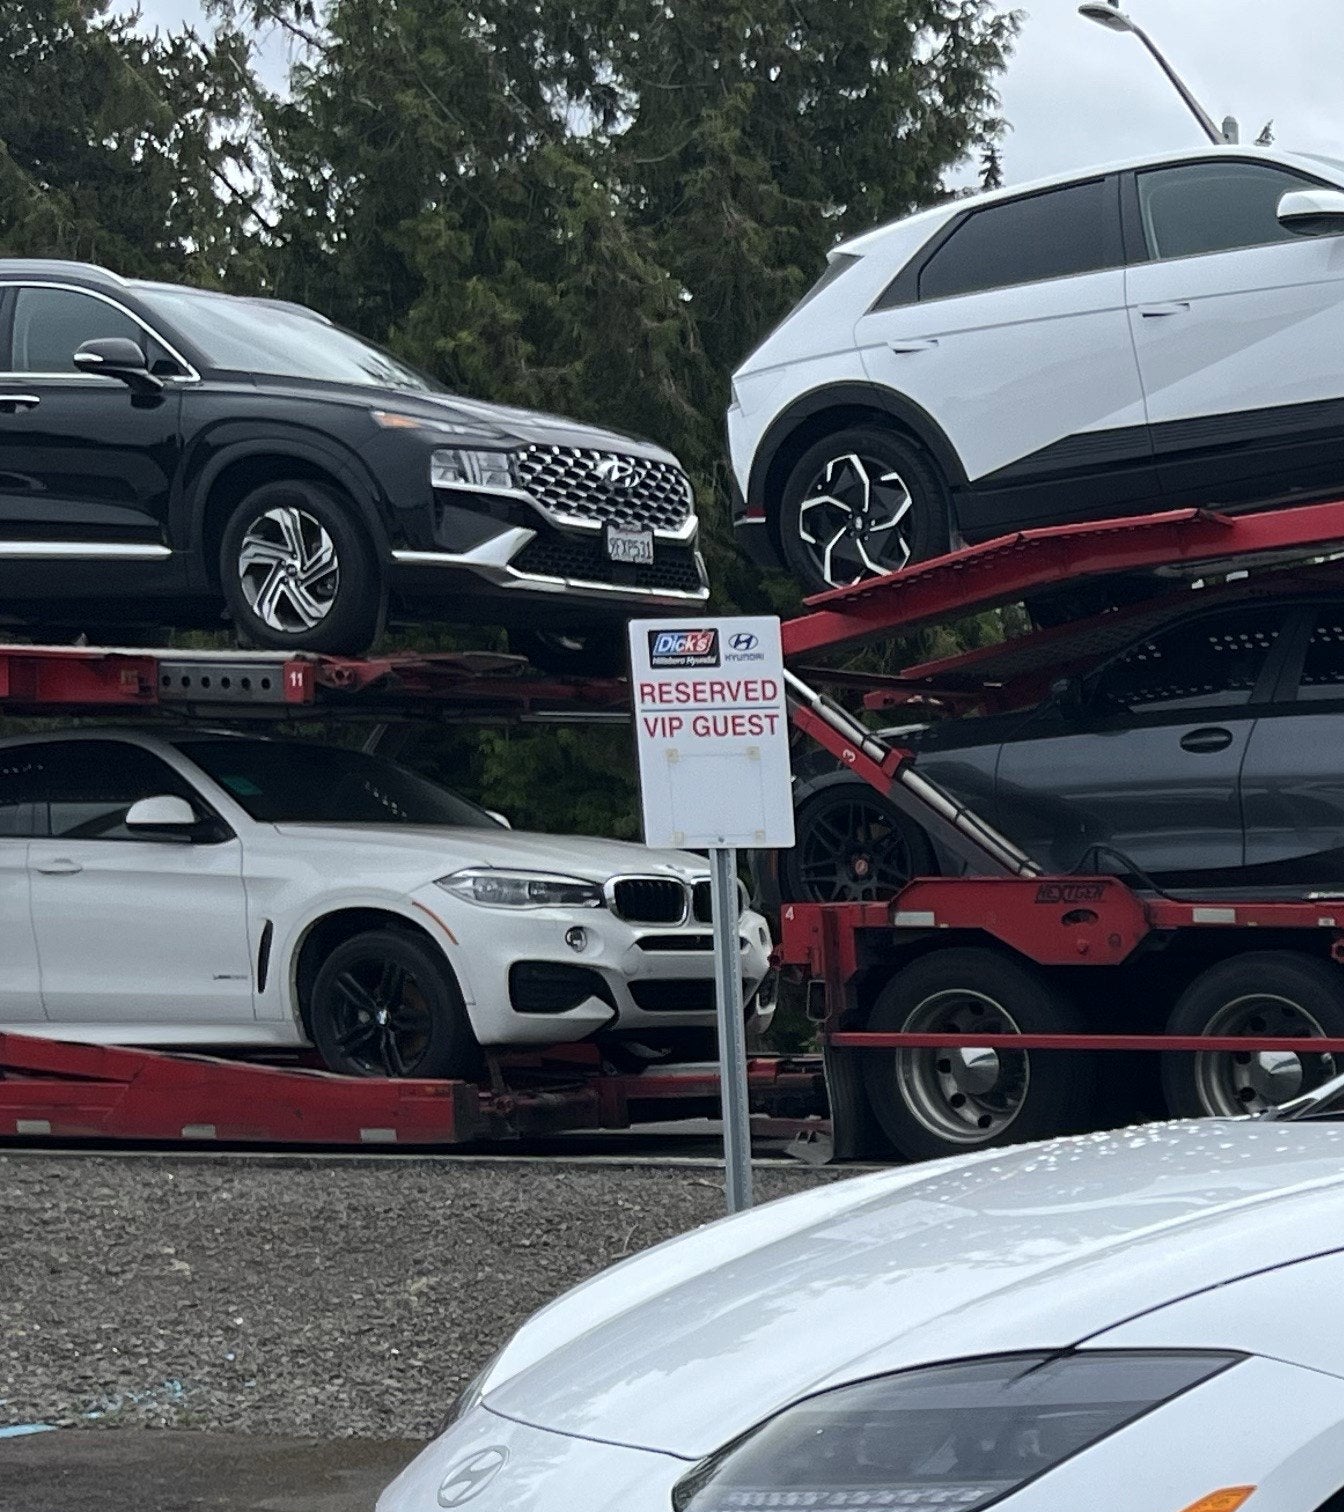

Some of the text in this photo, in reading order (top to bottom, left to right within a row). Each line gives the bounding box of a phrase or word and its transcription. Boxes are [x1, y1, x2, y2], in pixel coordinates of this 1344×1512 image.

[657, 633, 710, 652] Dick's
[724, 652, 765, 662] HYUNDAI
[289, 671, 303, 687] 11
[639, 679, 779, 704] RESERVED
[643, 714, 780, 739] VIP GUEST
